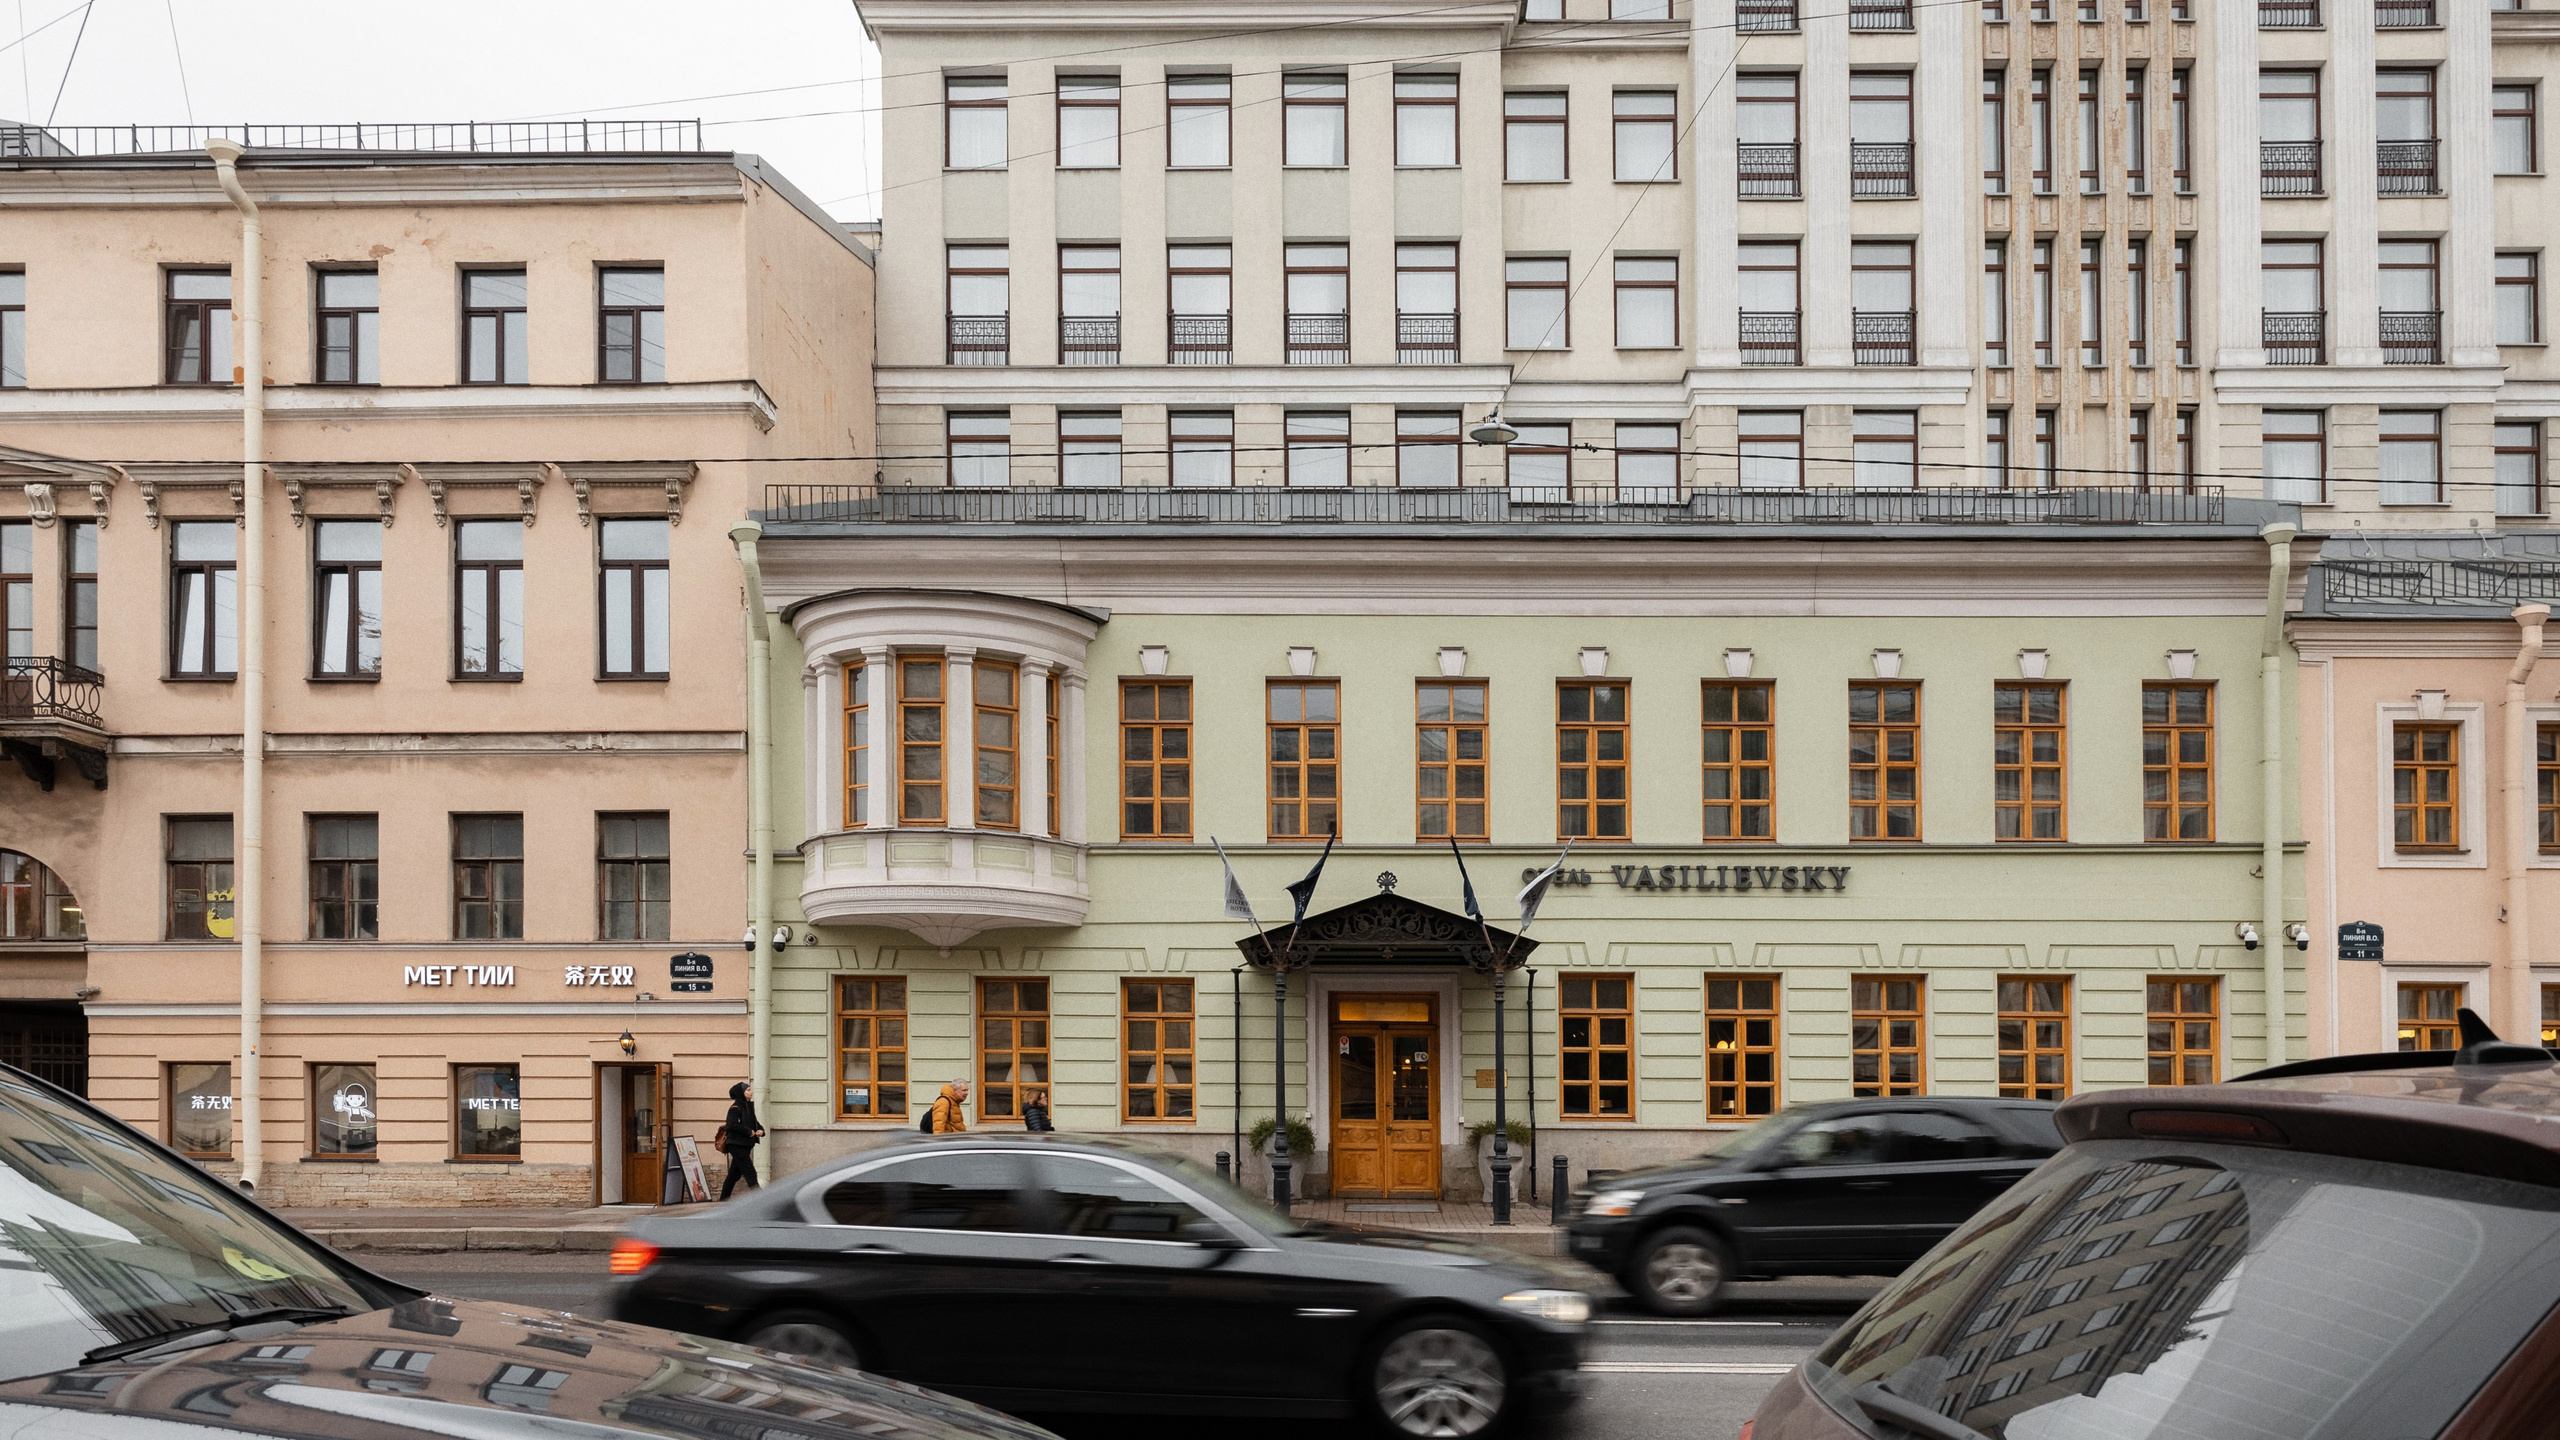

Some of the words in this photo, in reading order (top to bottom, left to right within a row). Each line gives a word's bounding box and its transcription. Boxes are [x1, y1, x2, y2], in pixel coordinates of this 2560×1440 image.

[1611, 864, 1851, 890] VASILIEVSKY
[2357, 950, 2365, 958] 11
[462, 965, 515, 986] ТИИ
[564, 965, 635, 986] 茶无双
[688, 983, 697, 991] 15
[468, 1098, 499, 1110] MET
[501, 1098, 521, 1110] TE
